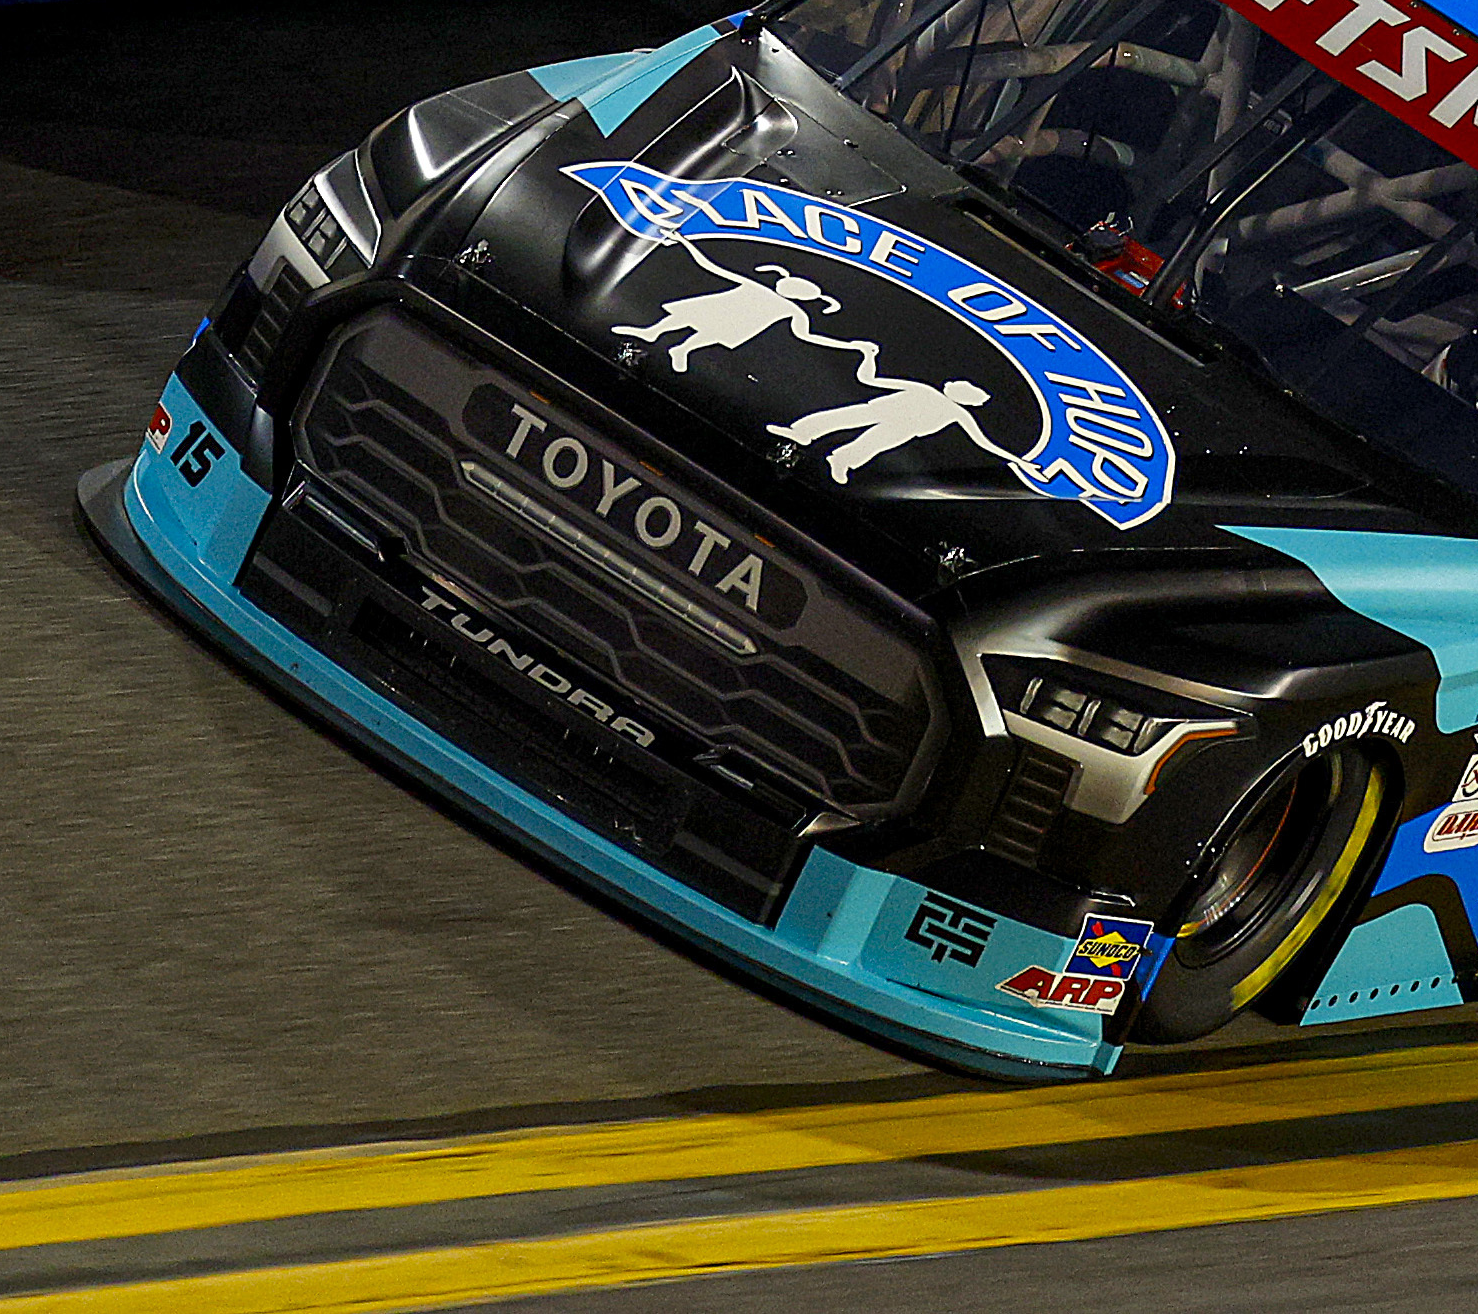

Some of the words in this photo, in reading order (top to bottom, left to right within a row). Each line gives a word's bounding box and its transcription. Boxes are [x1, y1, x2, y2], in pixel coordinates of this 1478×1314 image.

[948, 282, 1082, 352] OF
[170, 420, 225, 487] 15
[501, 403, 770, 615] TOYOTA
[418, 584, 658, 748] TUNDRA
[1302, 702, 1416, 758] GOODYEAR
[1080, 941, 1139, 959] SUNOCO
[1004, 966, 1122, 1006] ARP
